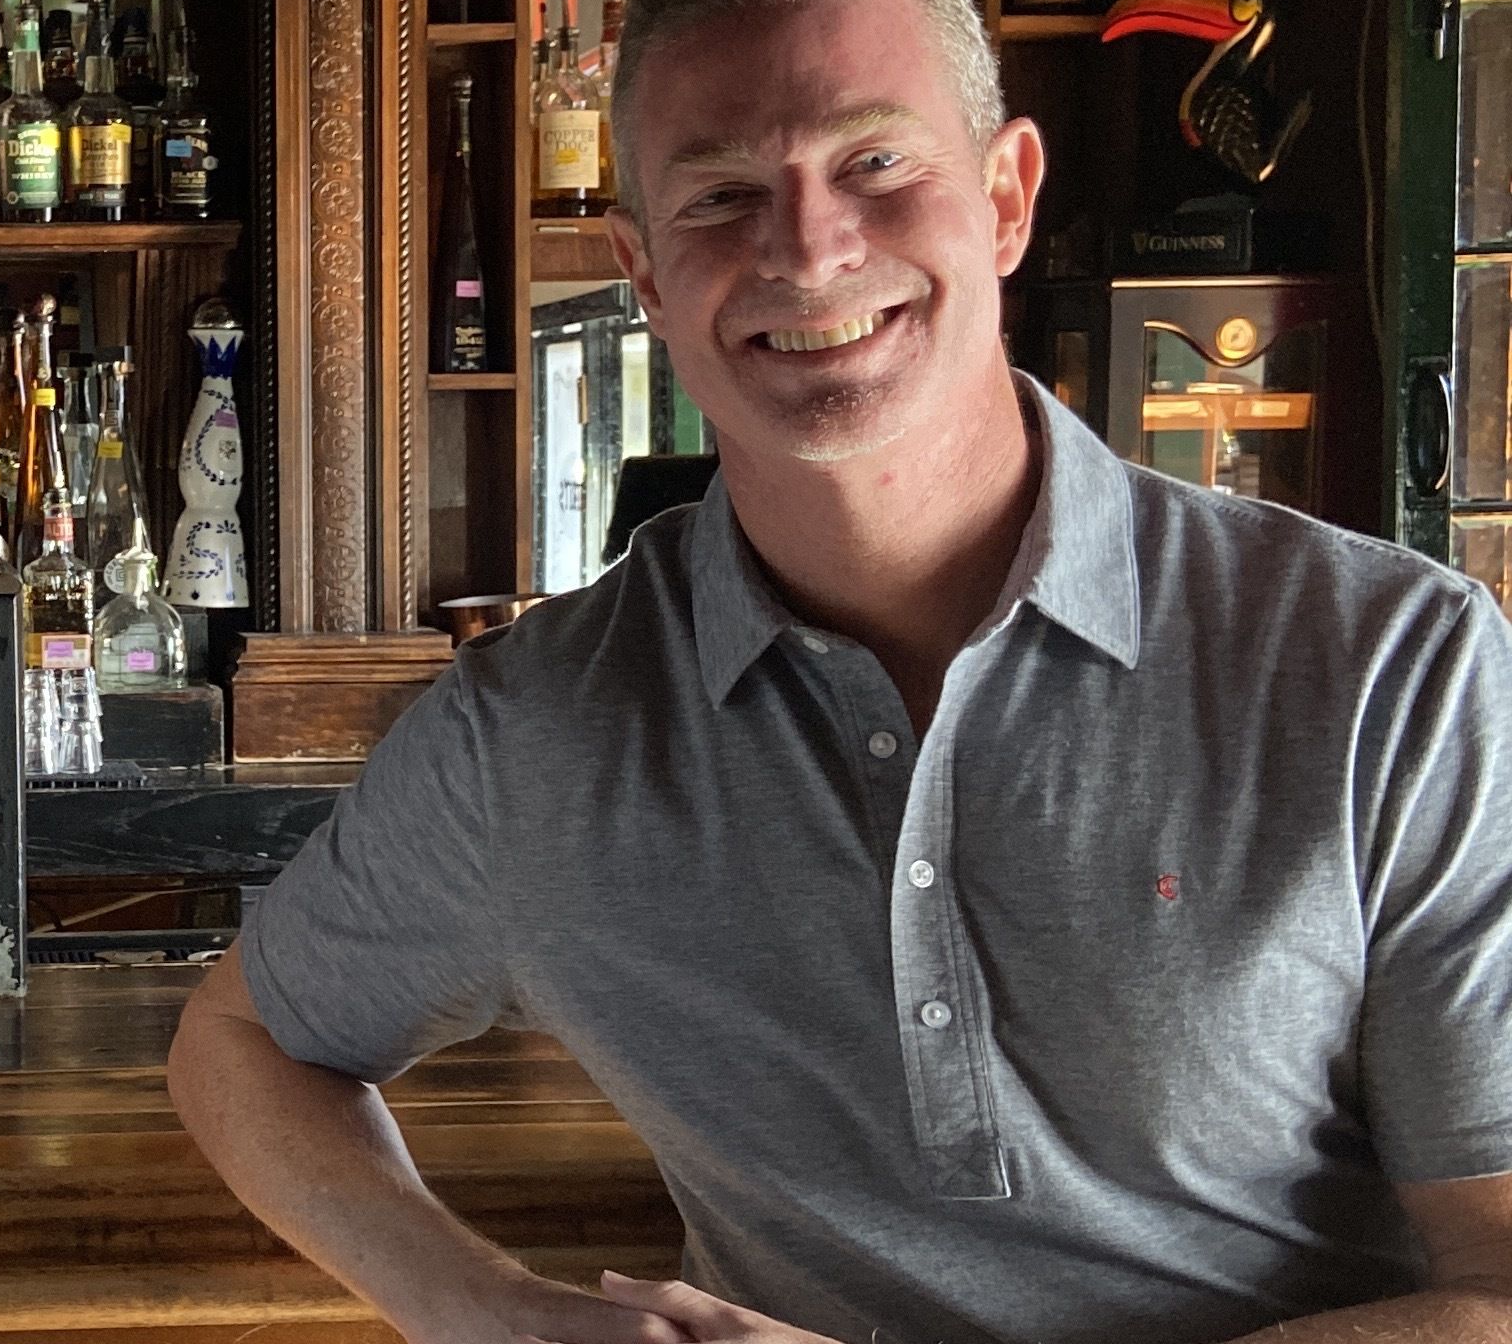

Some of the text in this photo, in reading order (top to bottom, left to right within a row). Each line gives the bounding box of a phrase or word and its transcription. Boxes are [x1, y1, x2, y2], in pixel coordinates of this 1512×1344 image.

[81, 137, 118, 151] Dickel
[544, 129, 595, 144] COPPER
[1149, 235, 1225, 252] GUINNESS
